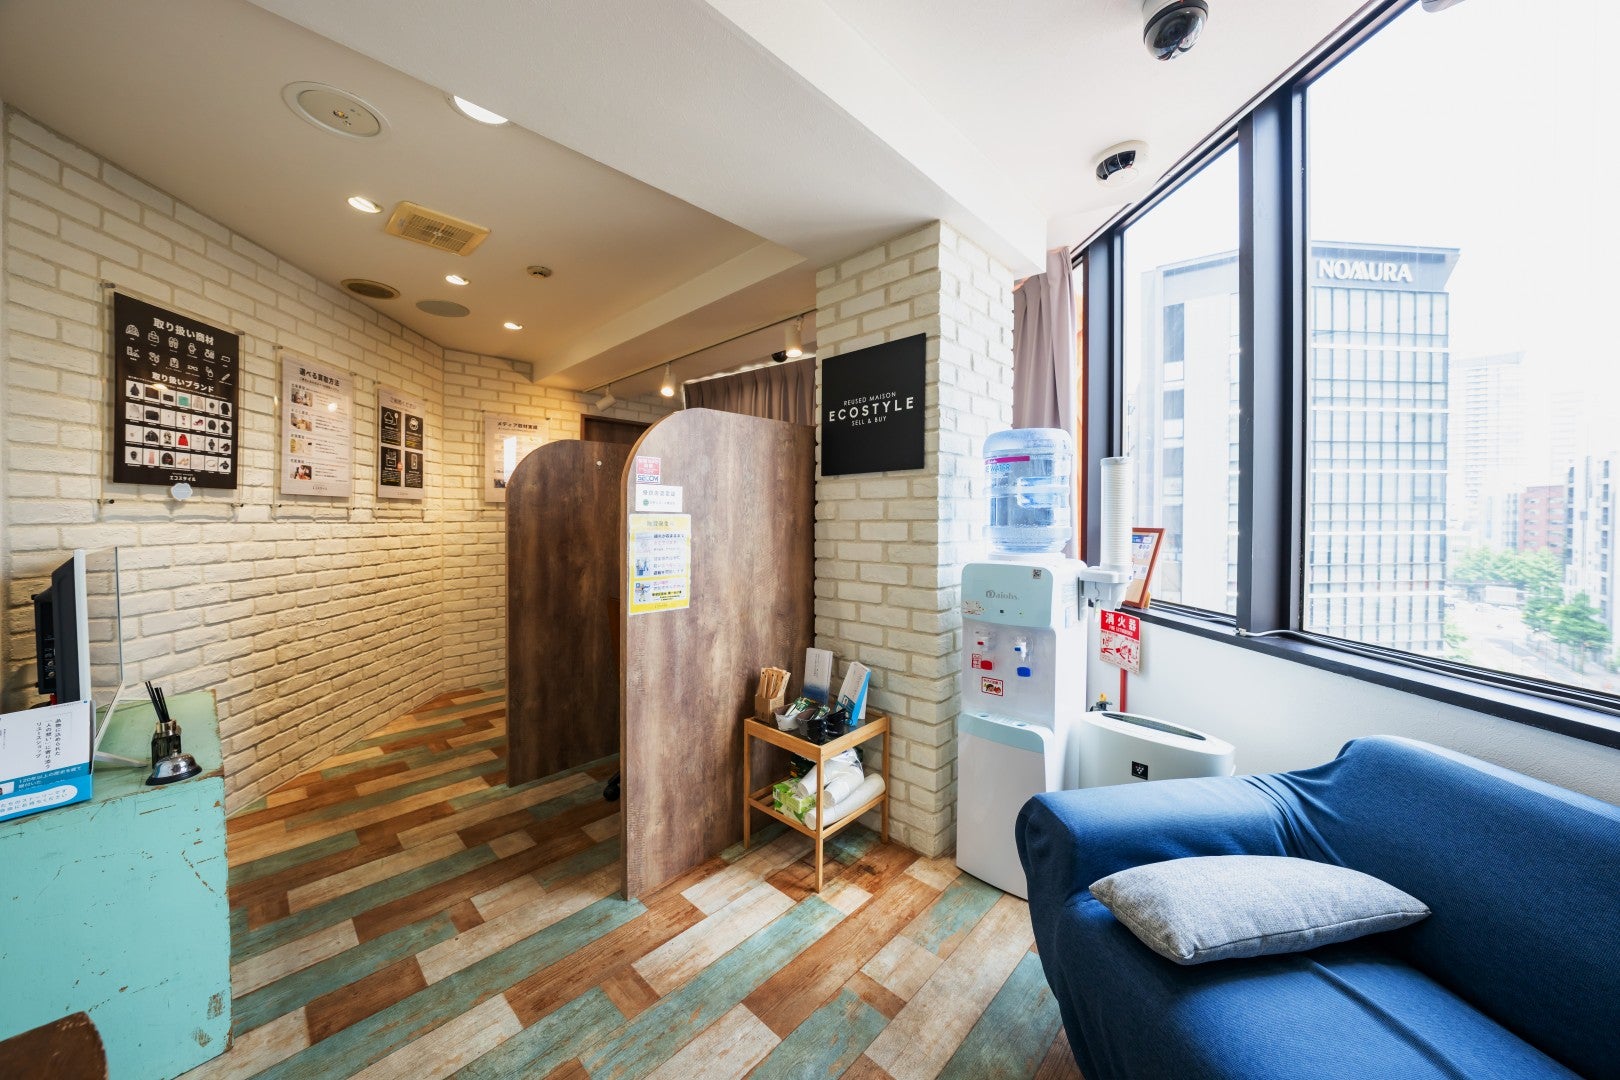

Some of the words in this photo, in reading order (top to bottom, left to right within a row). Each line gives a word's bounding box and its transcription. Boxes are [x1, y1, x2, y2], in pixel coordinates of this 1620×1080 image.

[1318, 258, 1413, 283] NOMURA
[153, 316, 214, 346] 取り扱い商材
[151, 371, 214, 393] 取り扱いブランド
[829, 396, 914, 422] ECOSTYLE
[843, 396, 867, 407] REUSED
[869, 391, 897, 402] MAISON
[874, 415, 887, 423] BUY
[1105, 612, 1136, 632] 消火器
